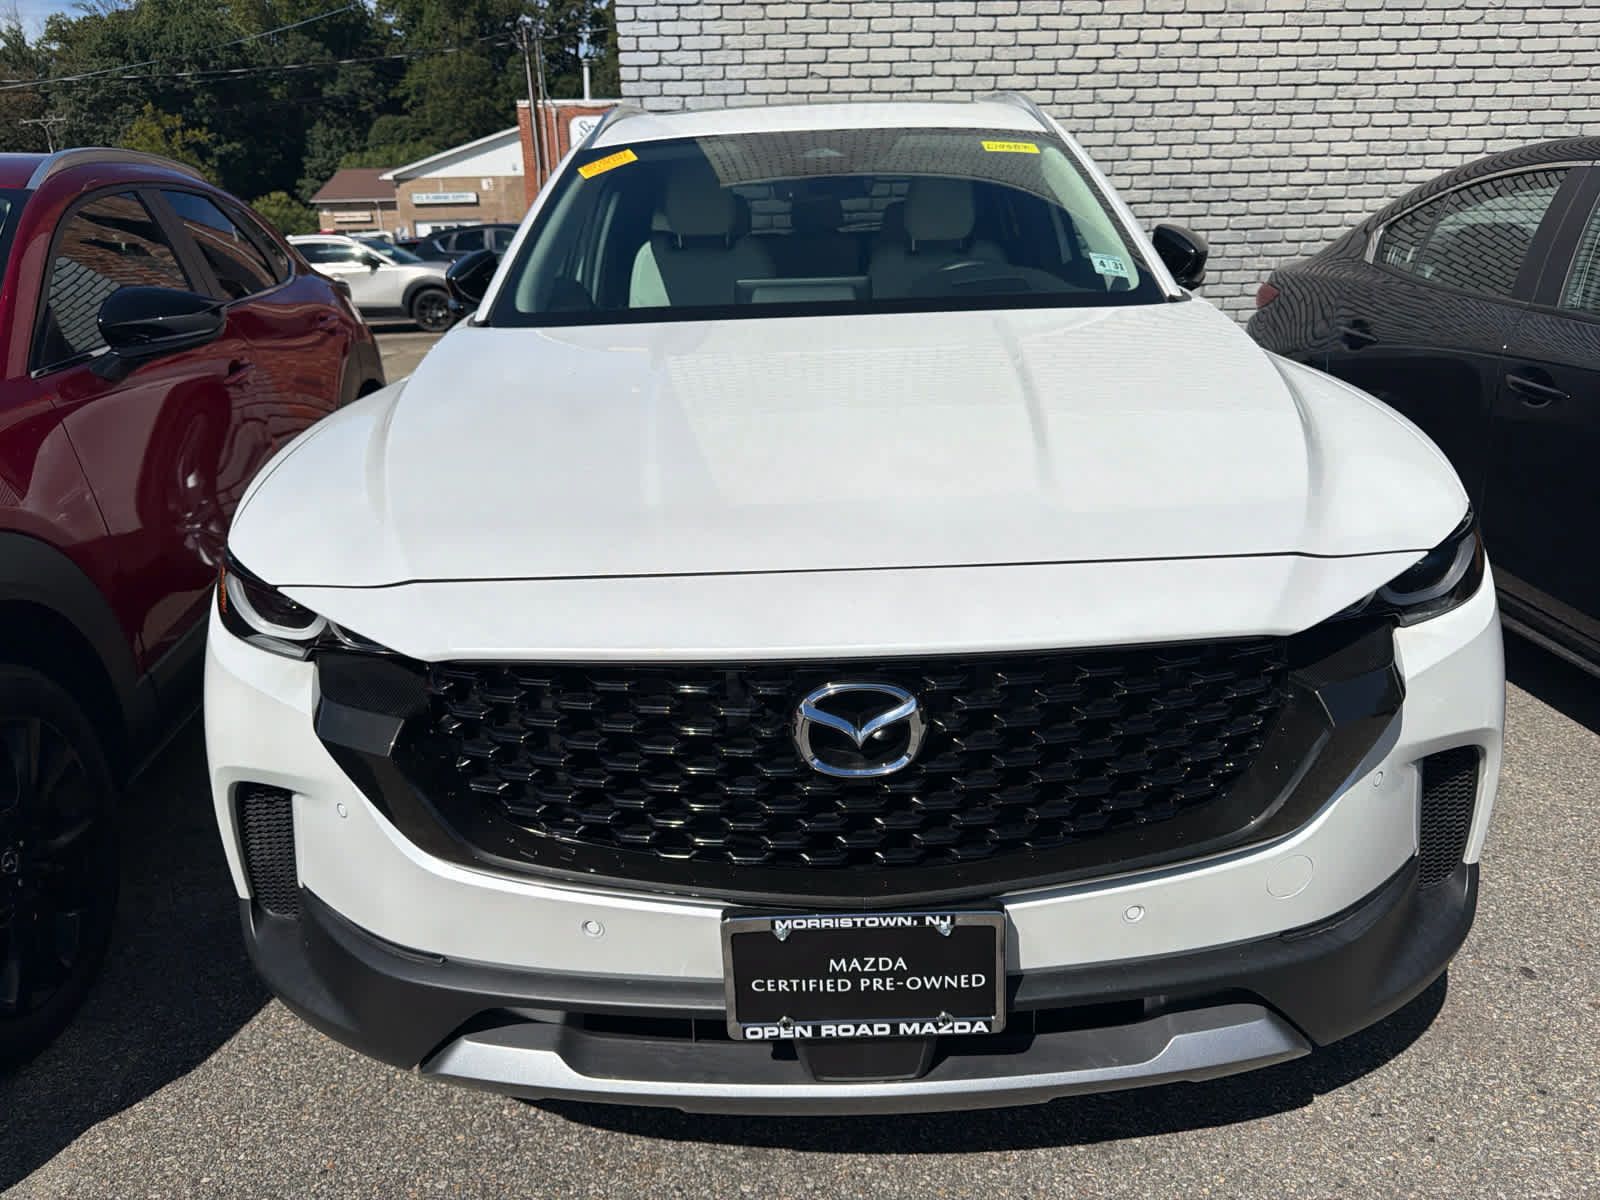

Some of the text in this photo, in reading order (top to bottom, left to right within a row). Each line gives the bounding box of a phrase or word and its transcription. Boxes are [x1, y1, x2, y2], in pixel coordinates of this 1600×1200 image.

[925, 915, 951, 926] NJ
[829, 957, 908, 973] MAZDA
[751, 974, 986, 992] CERTIFIED PRE-OWNED
[745, 1020, 990, 1040] OPEN ROAD MAZDA
